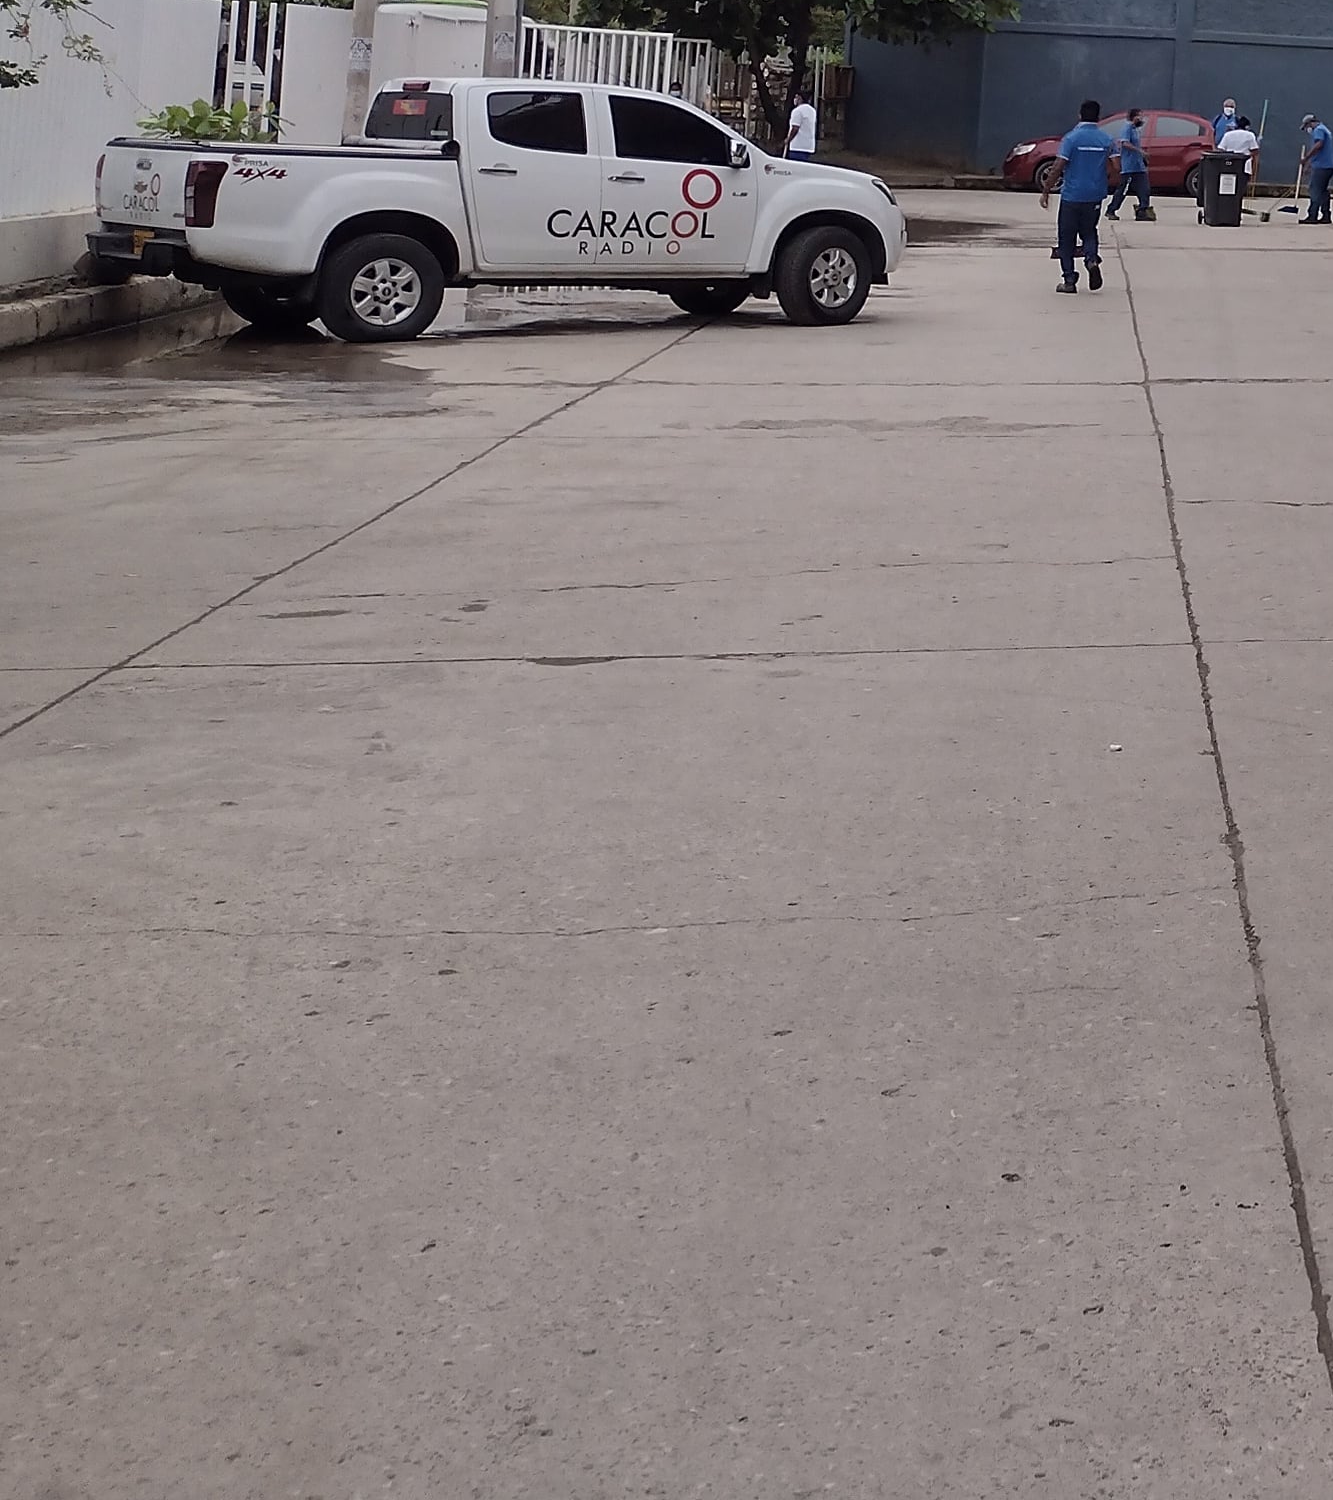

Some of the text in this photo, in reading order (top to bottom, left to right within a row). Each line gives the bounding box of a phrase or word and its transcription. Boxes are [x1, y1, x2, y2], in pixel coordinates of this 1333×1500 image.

[123, 194, 160, 212] CARACOL
[547, 209, 715, 239] CARACOL
[578, 240, 681, 255] RADIO
